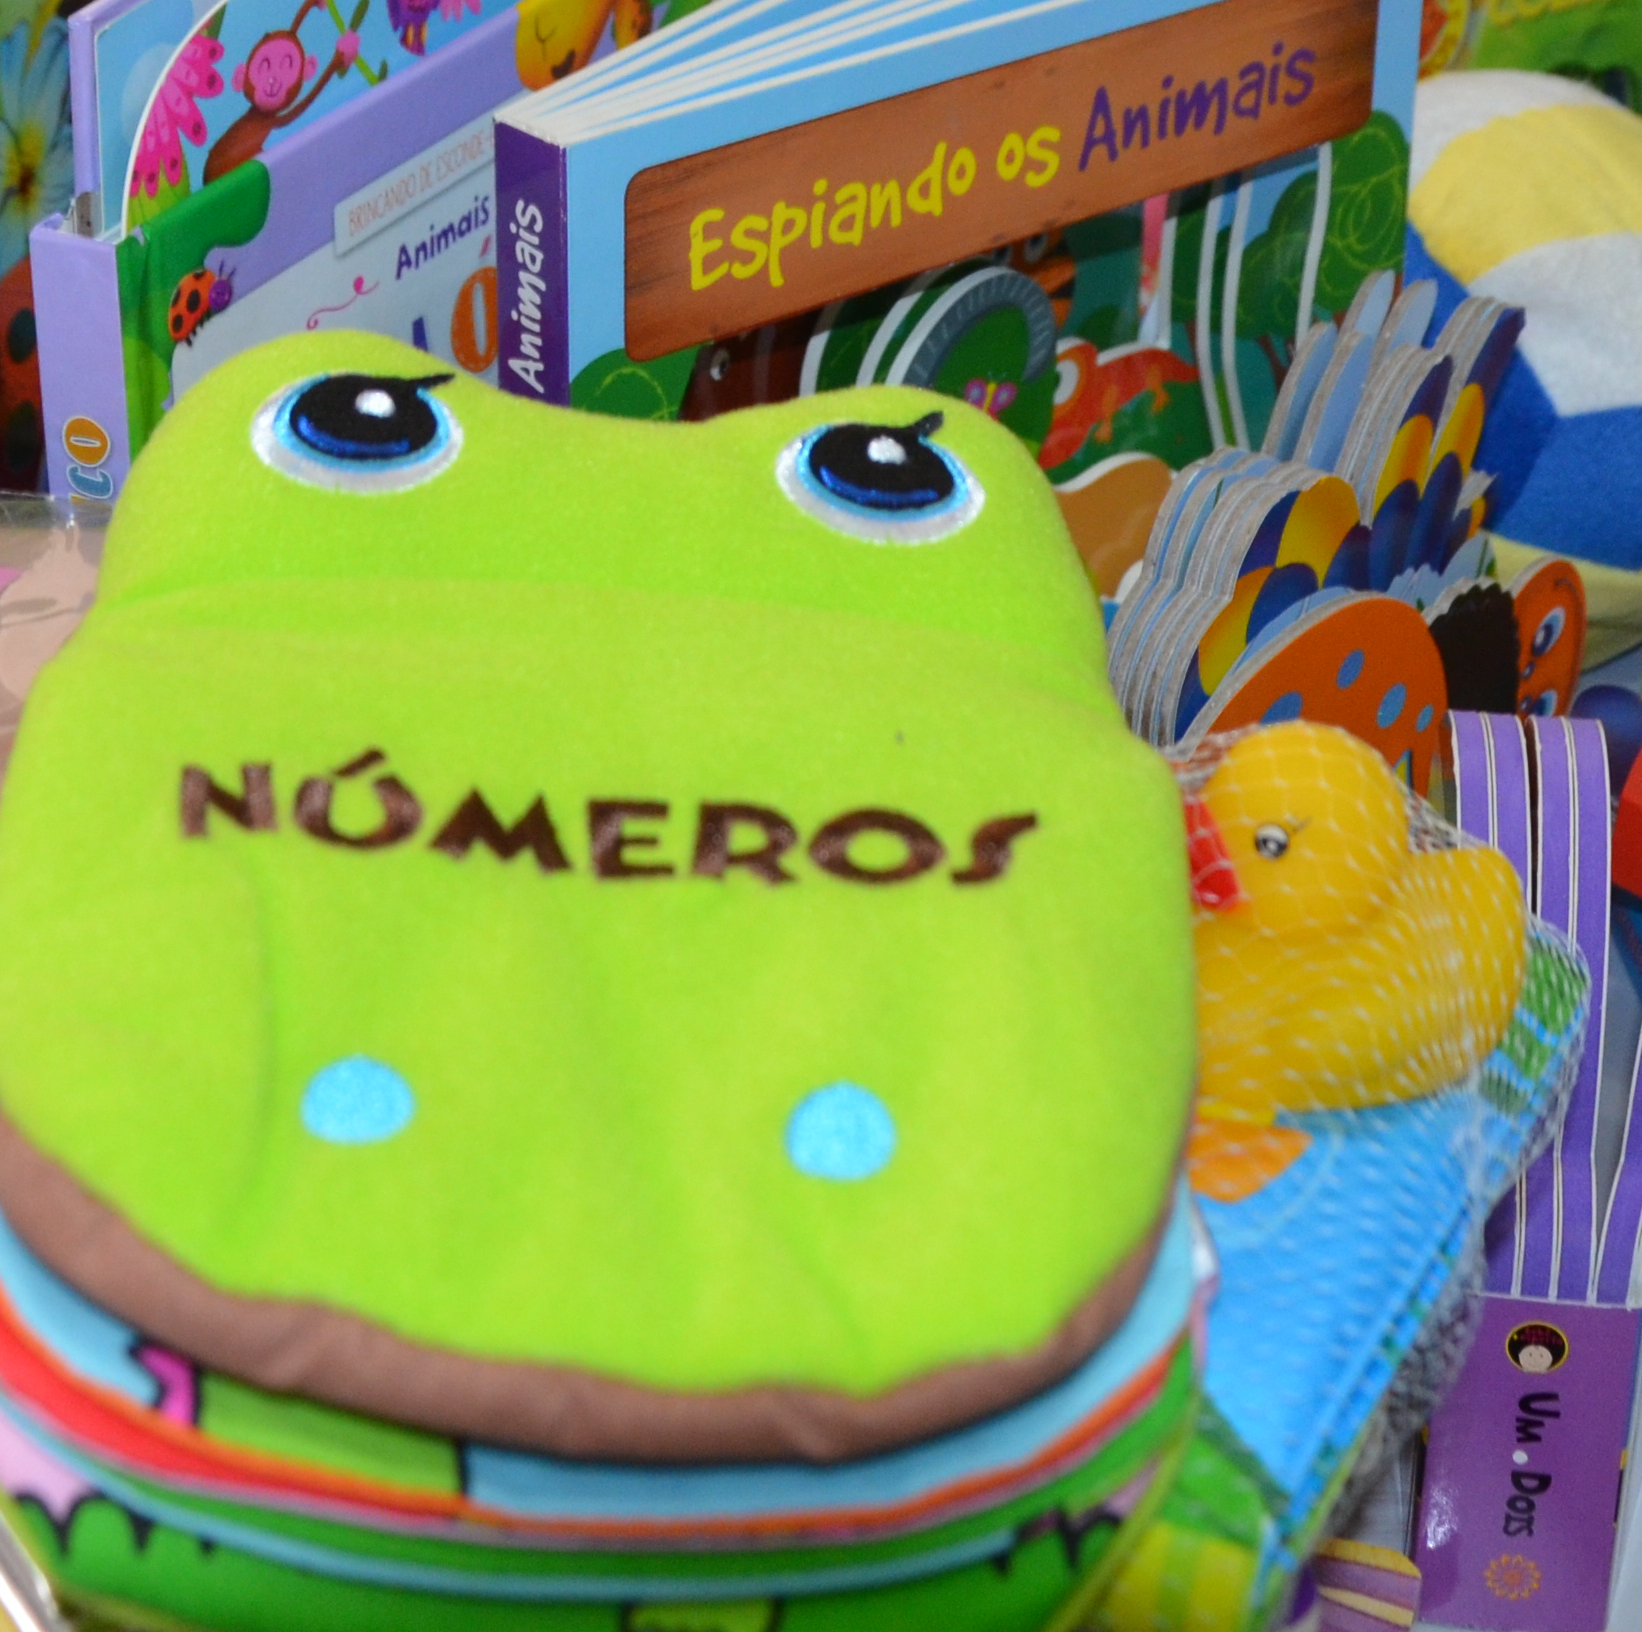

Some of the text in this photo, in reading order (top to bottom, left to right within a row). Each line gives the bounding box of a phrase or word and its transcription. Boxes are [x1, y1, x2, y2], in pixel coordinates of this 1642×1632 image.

[395, 194, 491, 281] Animais
[688, 40, 1320, 292] Espiando os Animais
[507, 197, 547, 395] Animais
[178, 745, 1040, 887] NÚMEROS
